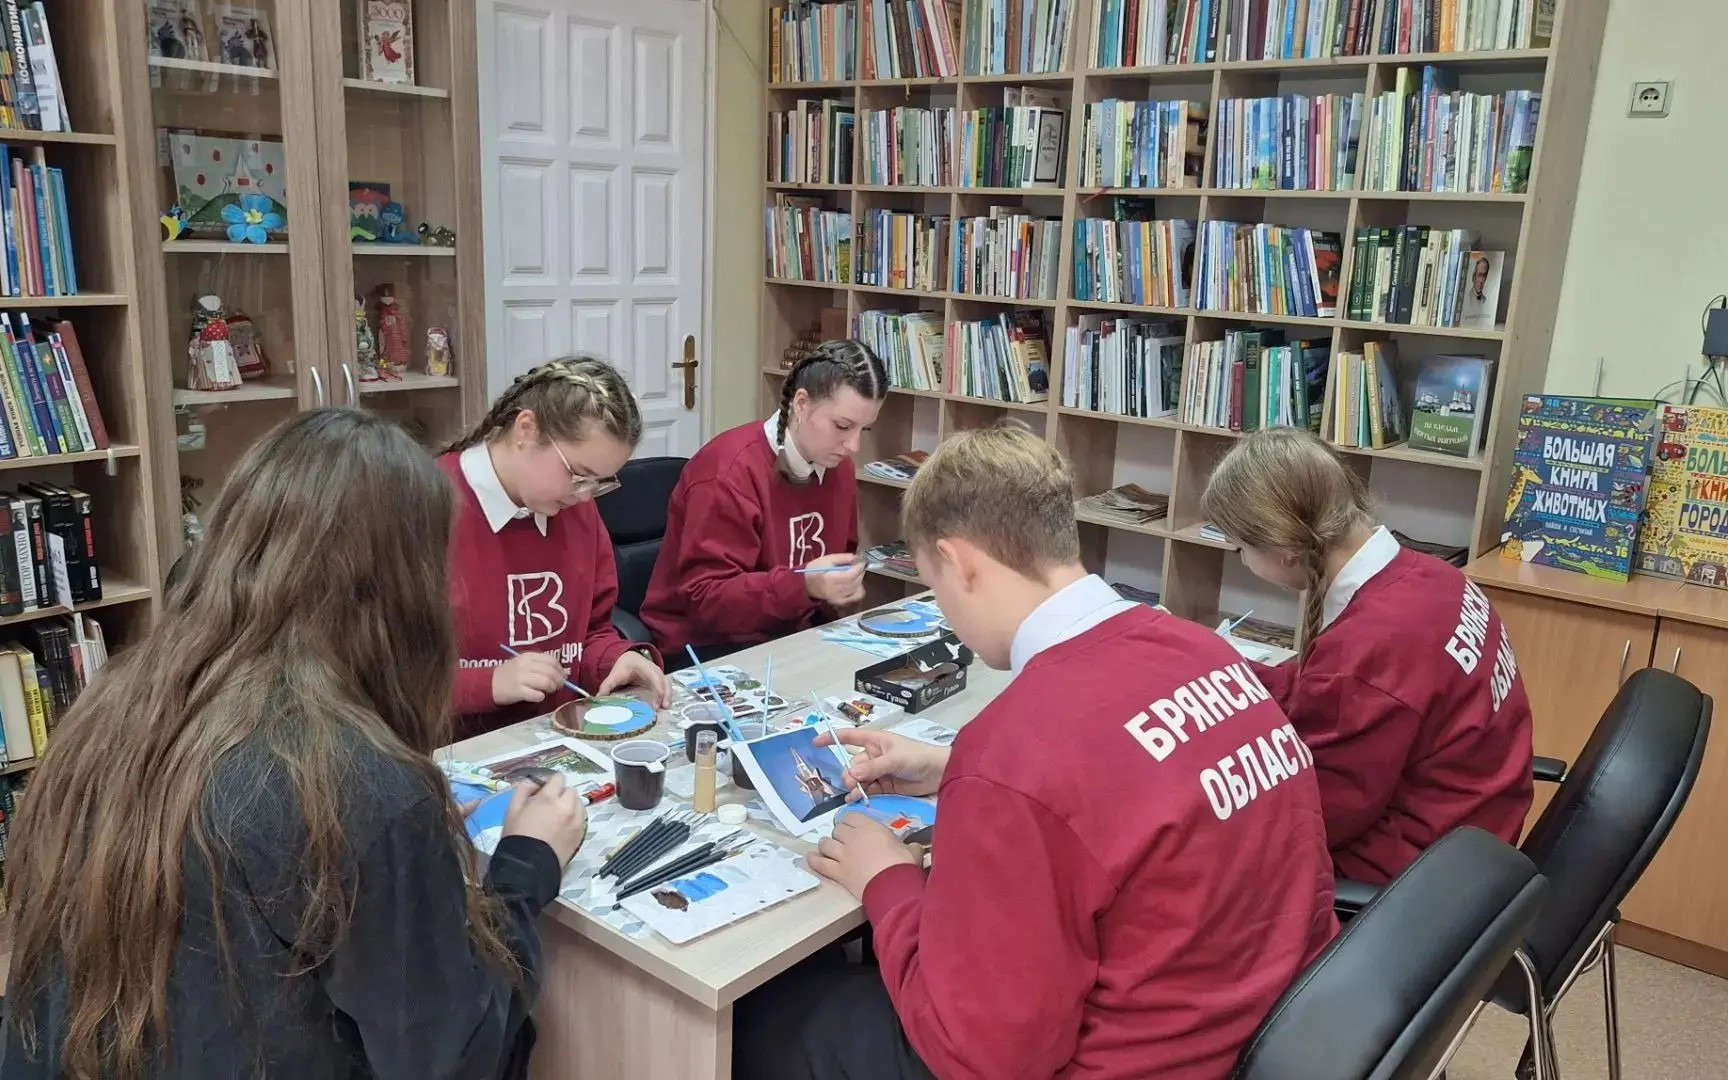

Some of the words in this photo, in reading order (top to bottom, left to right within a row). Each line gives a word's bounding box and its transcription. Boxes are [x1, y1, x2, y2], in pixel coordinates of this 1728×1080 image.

[1543, 435, 1616, 468] БОЛЬШАЯ
[1686, 447, 1728, 476] БОЛЬ
[1550, 465, 1599, 492] КНИГА
[1531, 489, 1608, 524] ЖИВОТНЫХ
[16, 532, 29, 564] МАХНО
[21, 563, 34, 598] НЕСТОР
[1445, 577, 1490, 675] БРЯНСК
[886, 692, 909, 706] Гуашь
[1123, 662, 1272, 763] БРЯНСК
